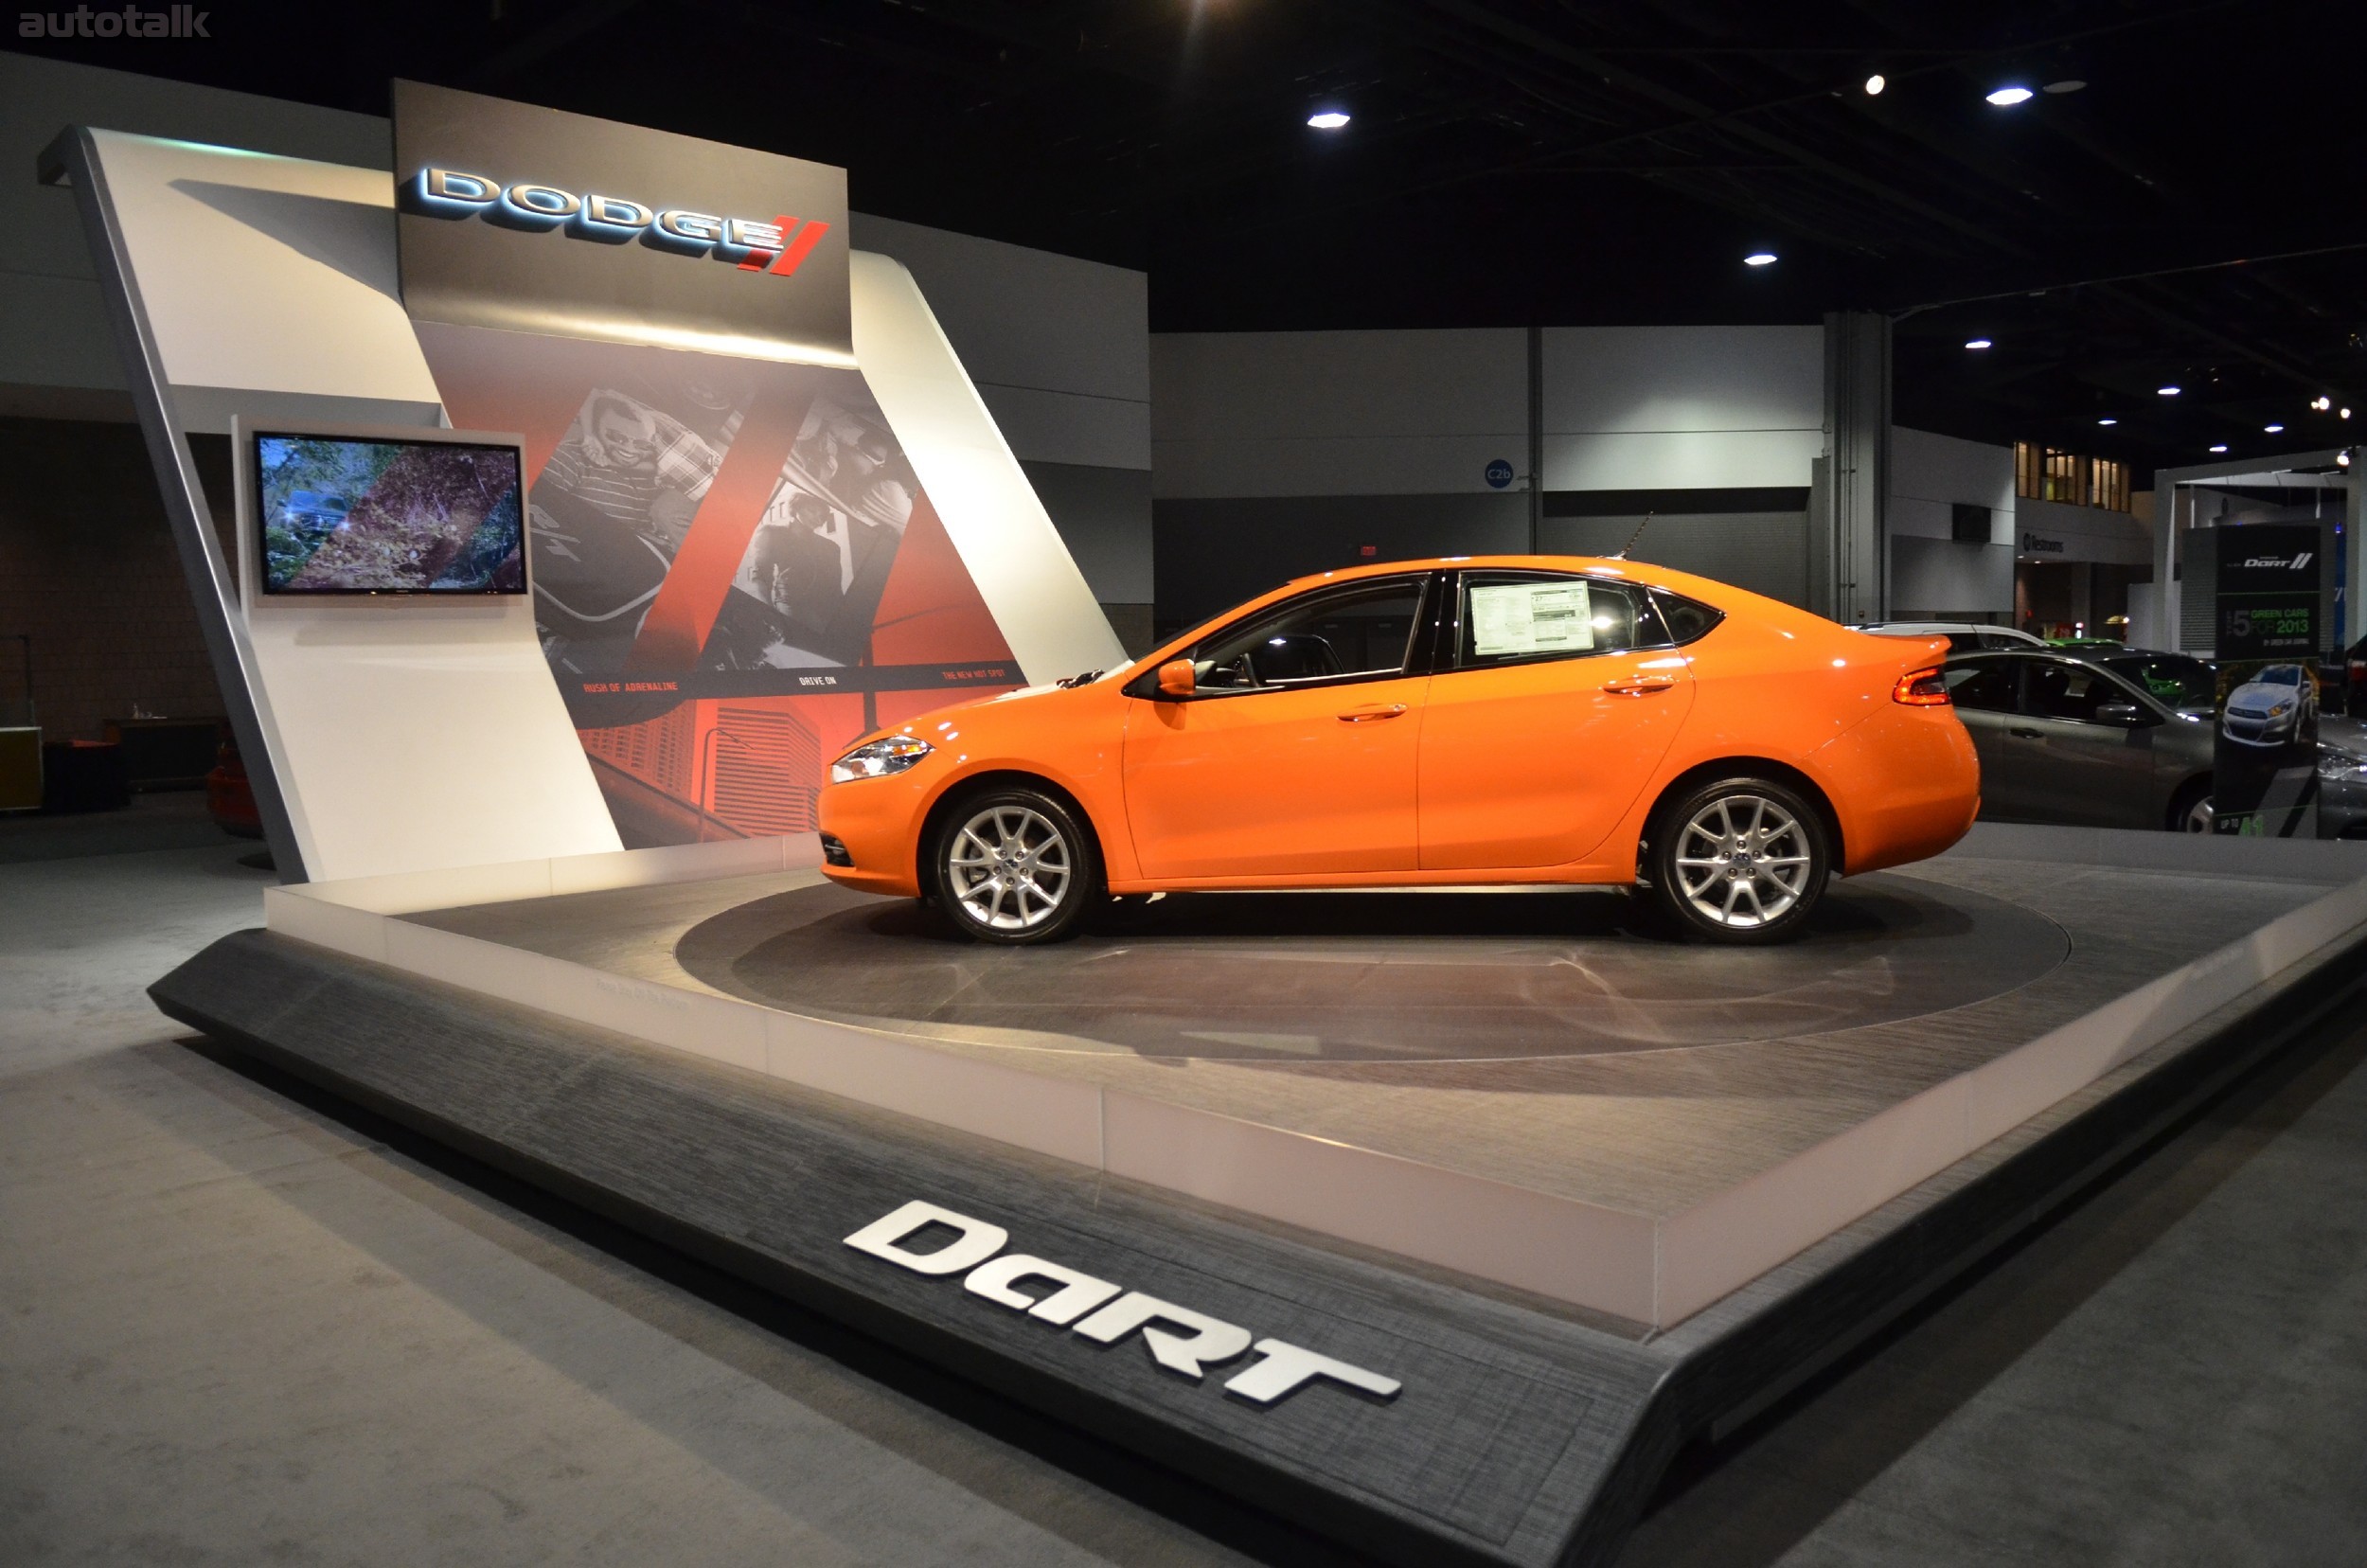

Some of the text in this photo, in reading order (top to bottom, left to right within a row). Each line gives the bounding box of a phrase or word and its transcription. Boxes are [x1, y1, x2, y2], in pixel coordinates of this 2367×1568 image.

[426, 167, 783, 253] DODGE
[1487, 469, 1511, 479] C2b
[2251, 609, 2309, 618] GREEN CARS
[2276, 619, 2309, 633] 2013
[942, 671, 957, 680] THE
[988, 669, 1006, 678] SPOT
[798, 676, 837, 686] DRIVE ON
[583, 682, 678, 692] RUSH OF ADRENALINE
